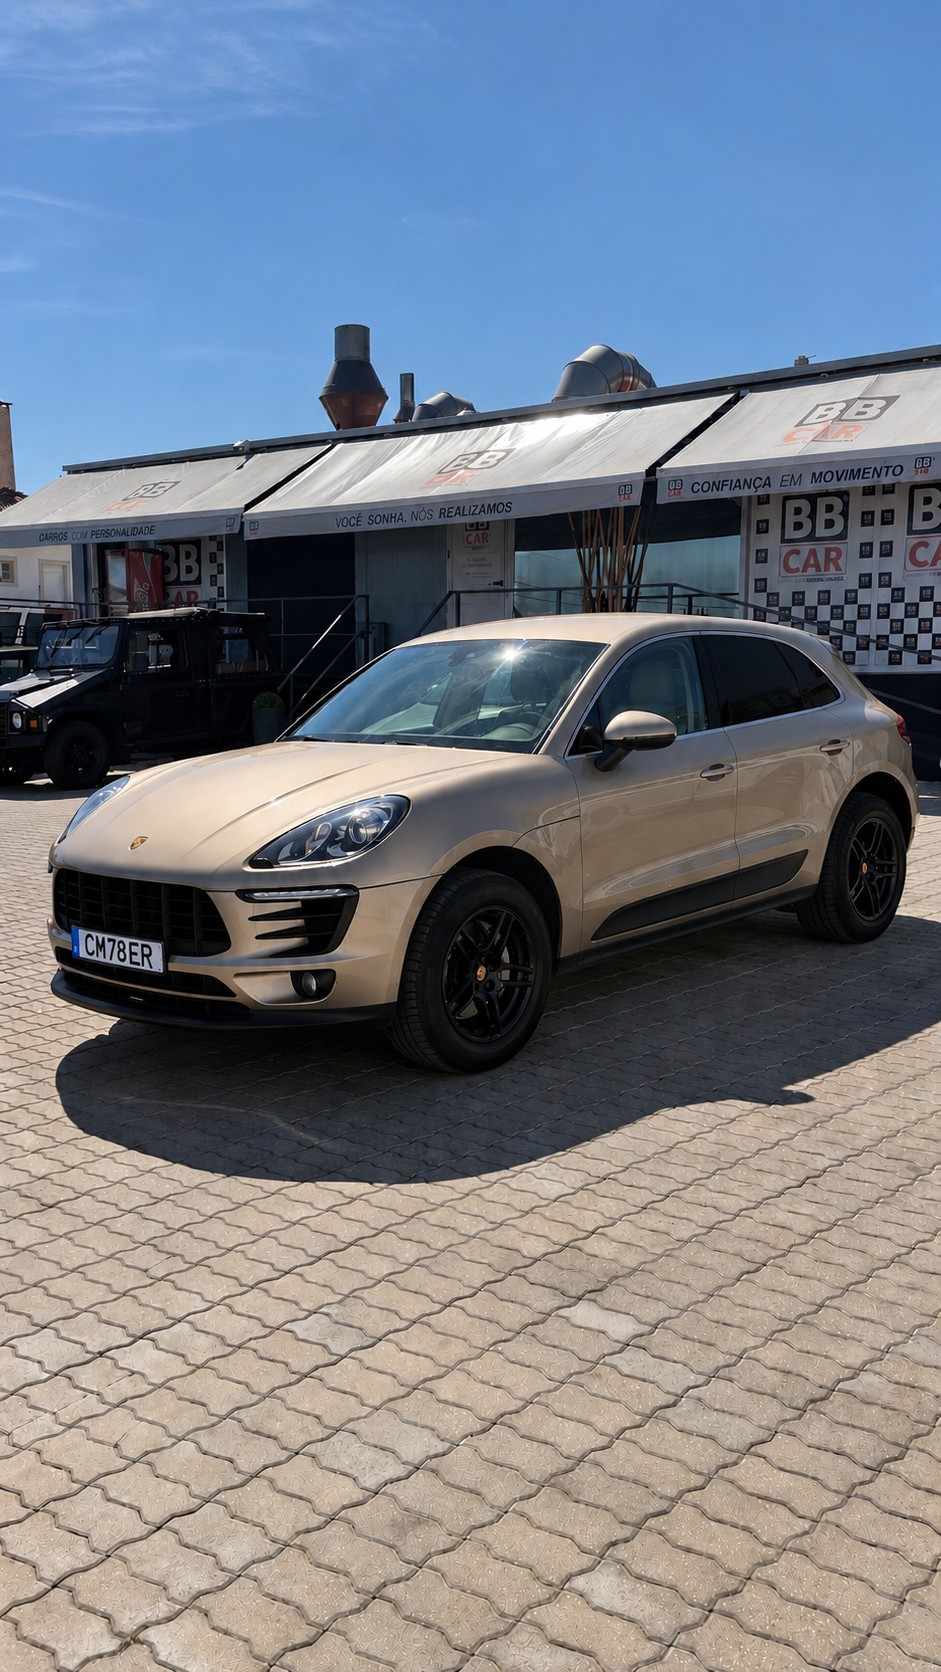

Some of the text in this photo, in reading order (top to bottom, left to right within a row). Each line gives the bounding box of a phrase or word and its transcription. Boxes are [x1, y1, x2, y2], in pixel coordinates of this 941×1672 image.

[801, 399, 888, 425] BB
[691, 476, 772, 494] CONFIANÇA
[780, 473, 802, 488] EM
[811, 464, 904, 484] MOVIMENTO
[411, 508, 433, 521] NÓS
[438, 502, 512, 519] REALIZAMOS
[784, 496, 845, 539] BB
[39, 531, 68, 542] CARROS
[90, 525, 156, 539] PERSONALIDADE
[783, 546, 843, 574] CAR
[85, 933, 153, 969] CM78ER
